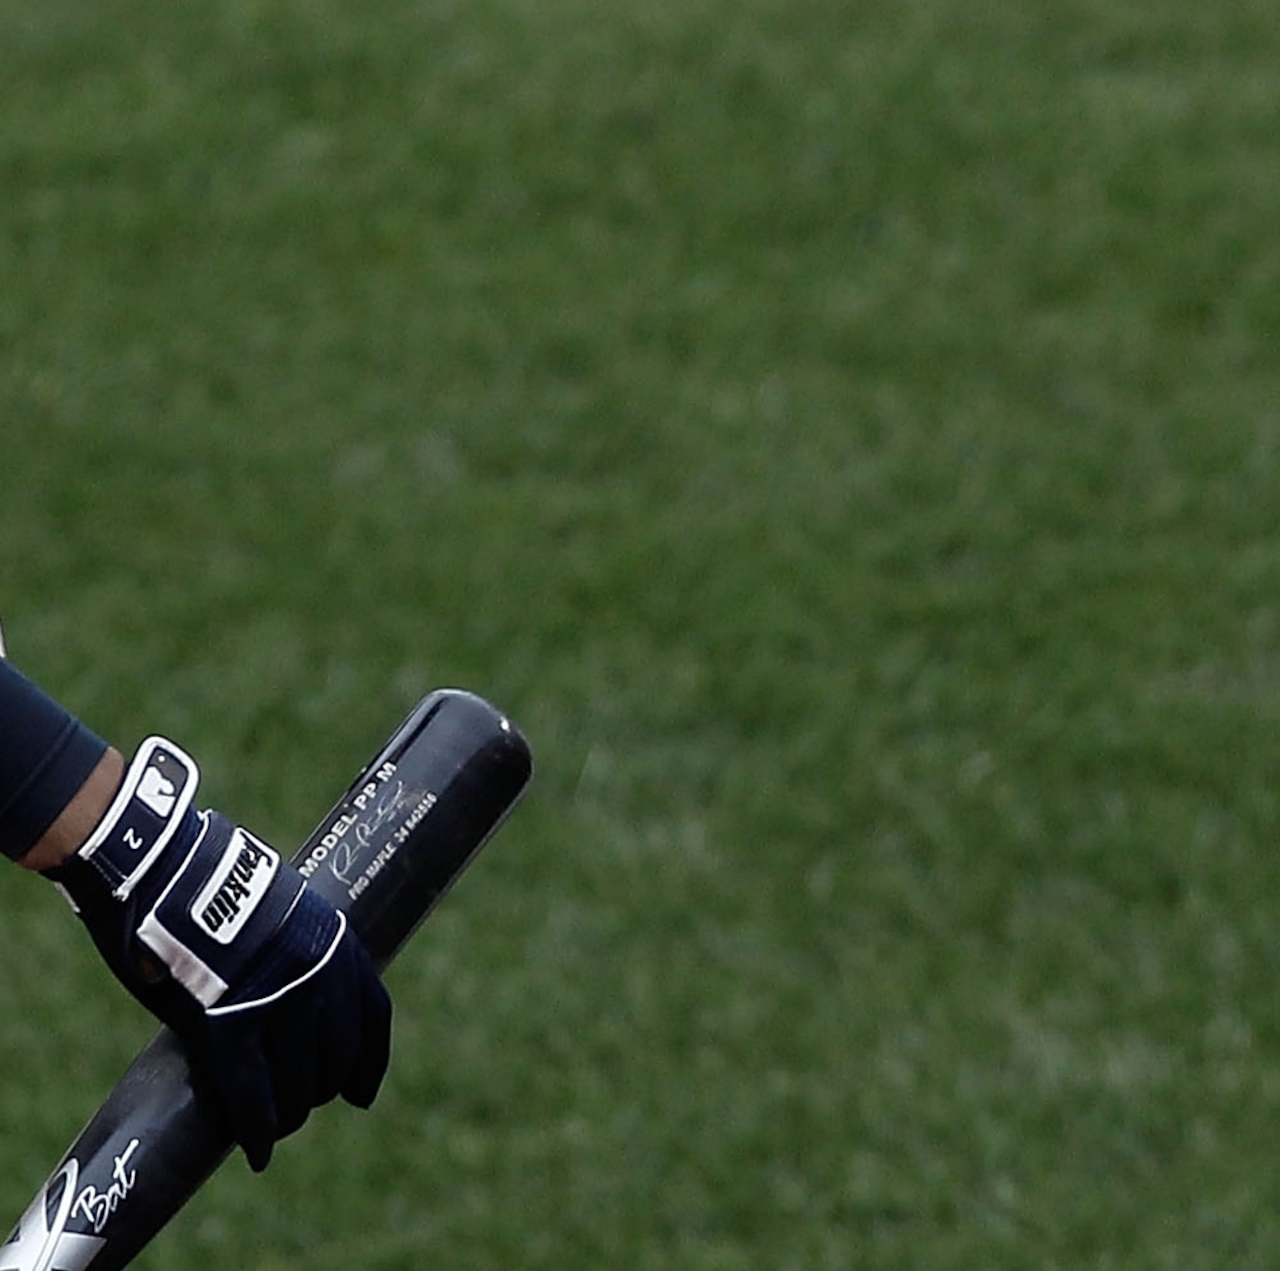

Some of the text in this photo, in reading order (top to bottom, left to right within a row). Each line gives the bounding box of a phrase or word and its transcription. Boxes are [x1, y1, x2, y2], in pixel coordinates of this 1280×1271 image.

[122, 828, 143, 850] 2
[298, 812, 358, 878] MODEL
[376, 761, 398, 783] M
[365, 841, 397, 879] MAPLE
[70, 1139, 140, 1234] Bat
